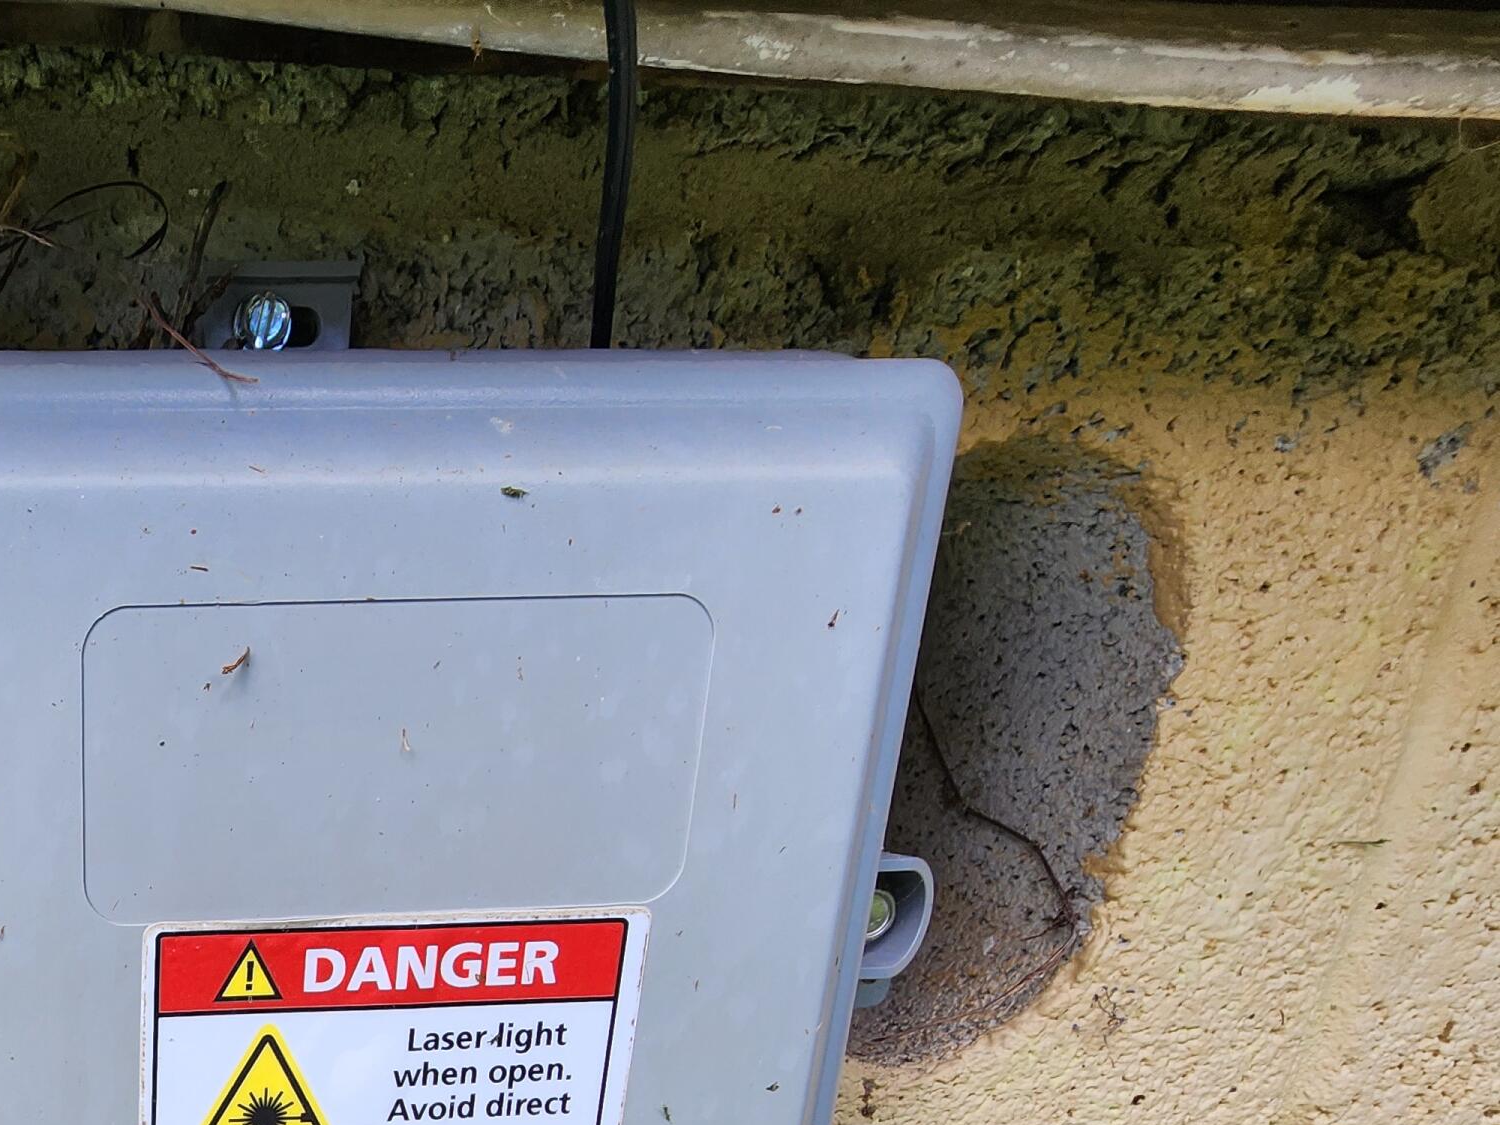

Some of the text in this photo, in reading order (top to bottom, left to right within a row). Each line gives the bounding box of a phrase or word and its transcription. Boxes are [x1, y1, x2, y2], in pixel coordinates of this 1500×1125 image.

[303, 940, 560, 993] DANGER
[407, 1020, 568, 1053] Laser light
[393, 1061, 572, 1089] when open.
[386, 1092, 571, 1122] Avoid direct
